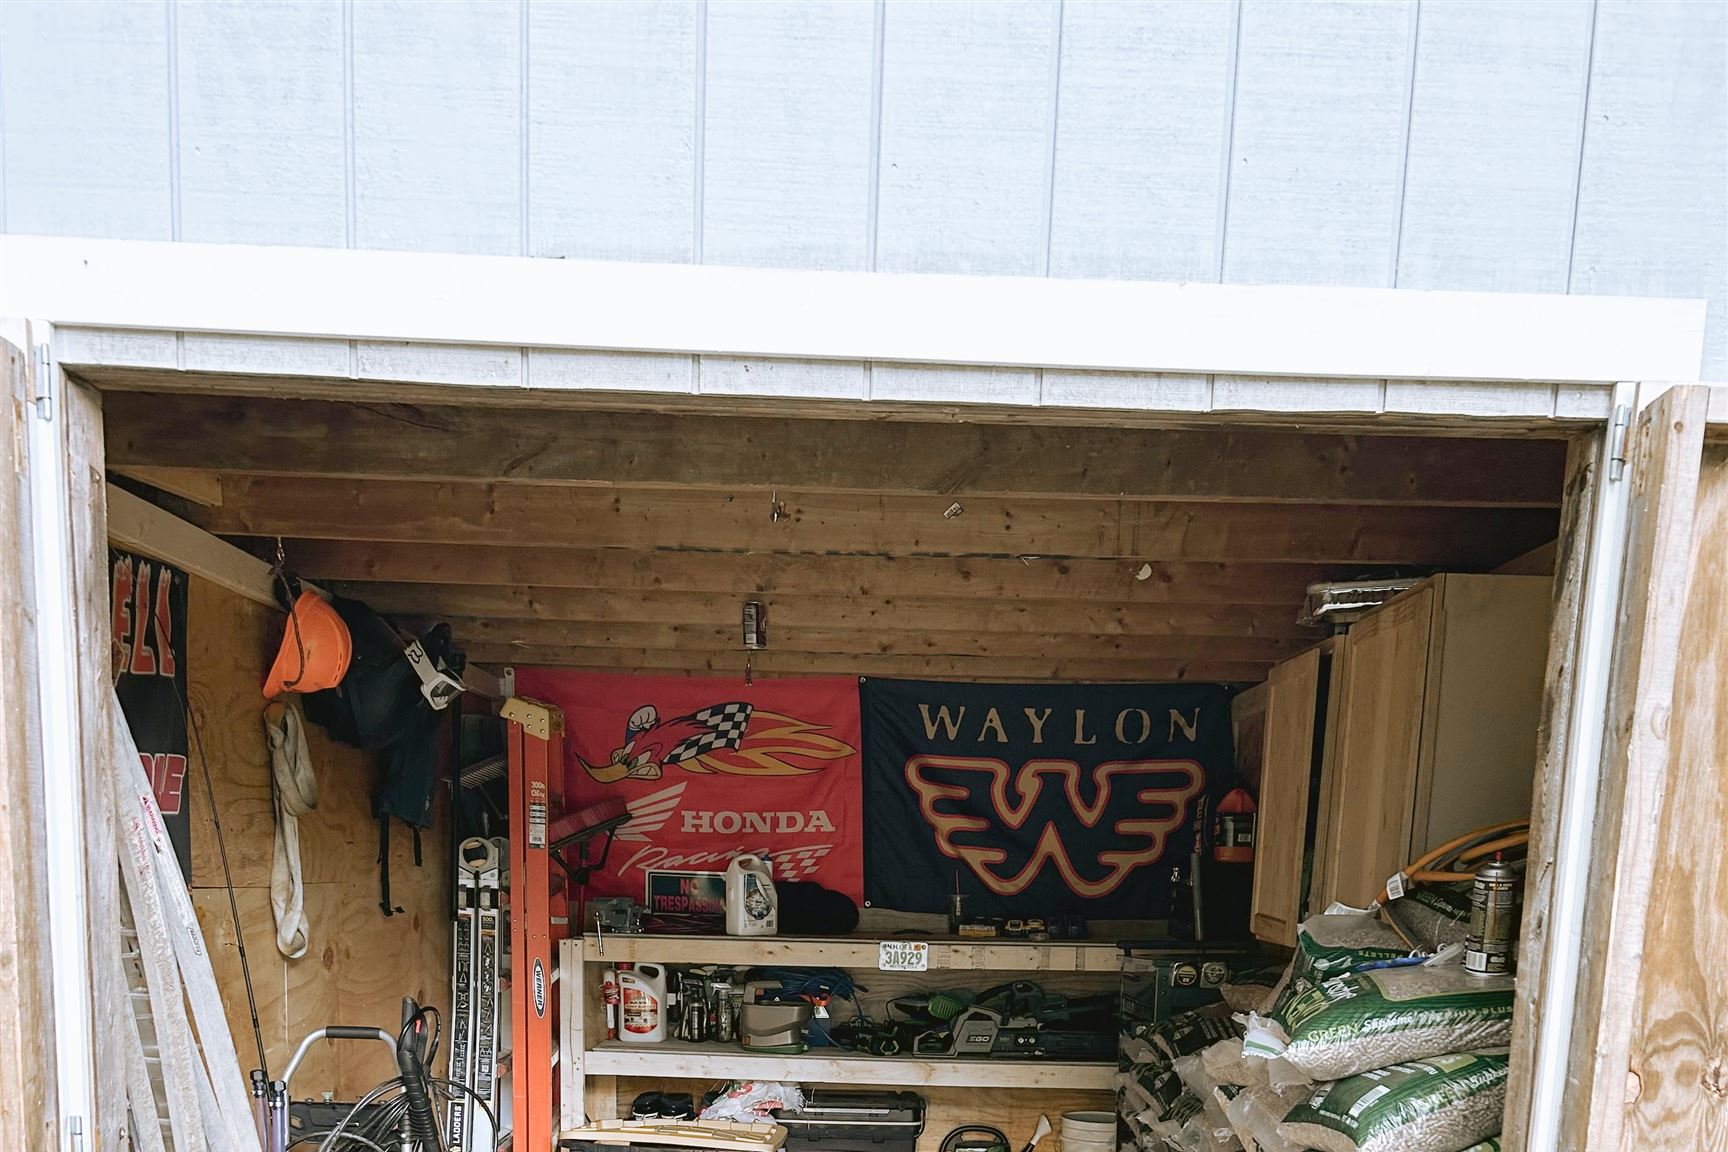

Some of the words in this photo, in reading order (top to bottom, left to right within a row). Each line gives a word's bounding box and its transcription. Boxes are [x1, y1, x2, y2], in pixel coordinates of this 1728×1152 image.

[918, 703, 1200, 744] WAYLON
[680, 810, 836, 834] HONDA
[618, 844, 833, 877] Racin
[654, 895, 724, 912] TRESPASSIN
[885, 951, 922, 965] 3A929
[535, 969, 543, 1006] WERNER
[1308, 1022, 1362, 1043] GREEN
[452, 1105, 462, 1144] LADDERS
